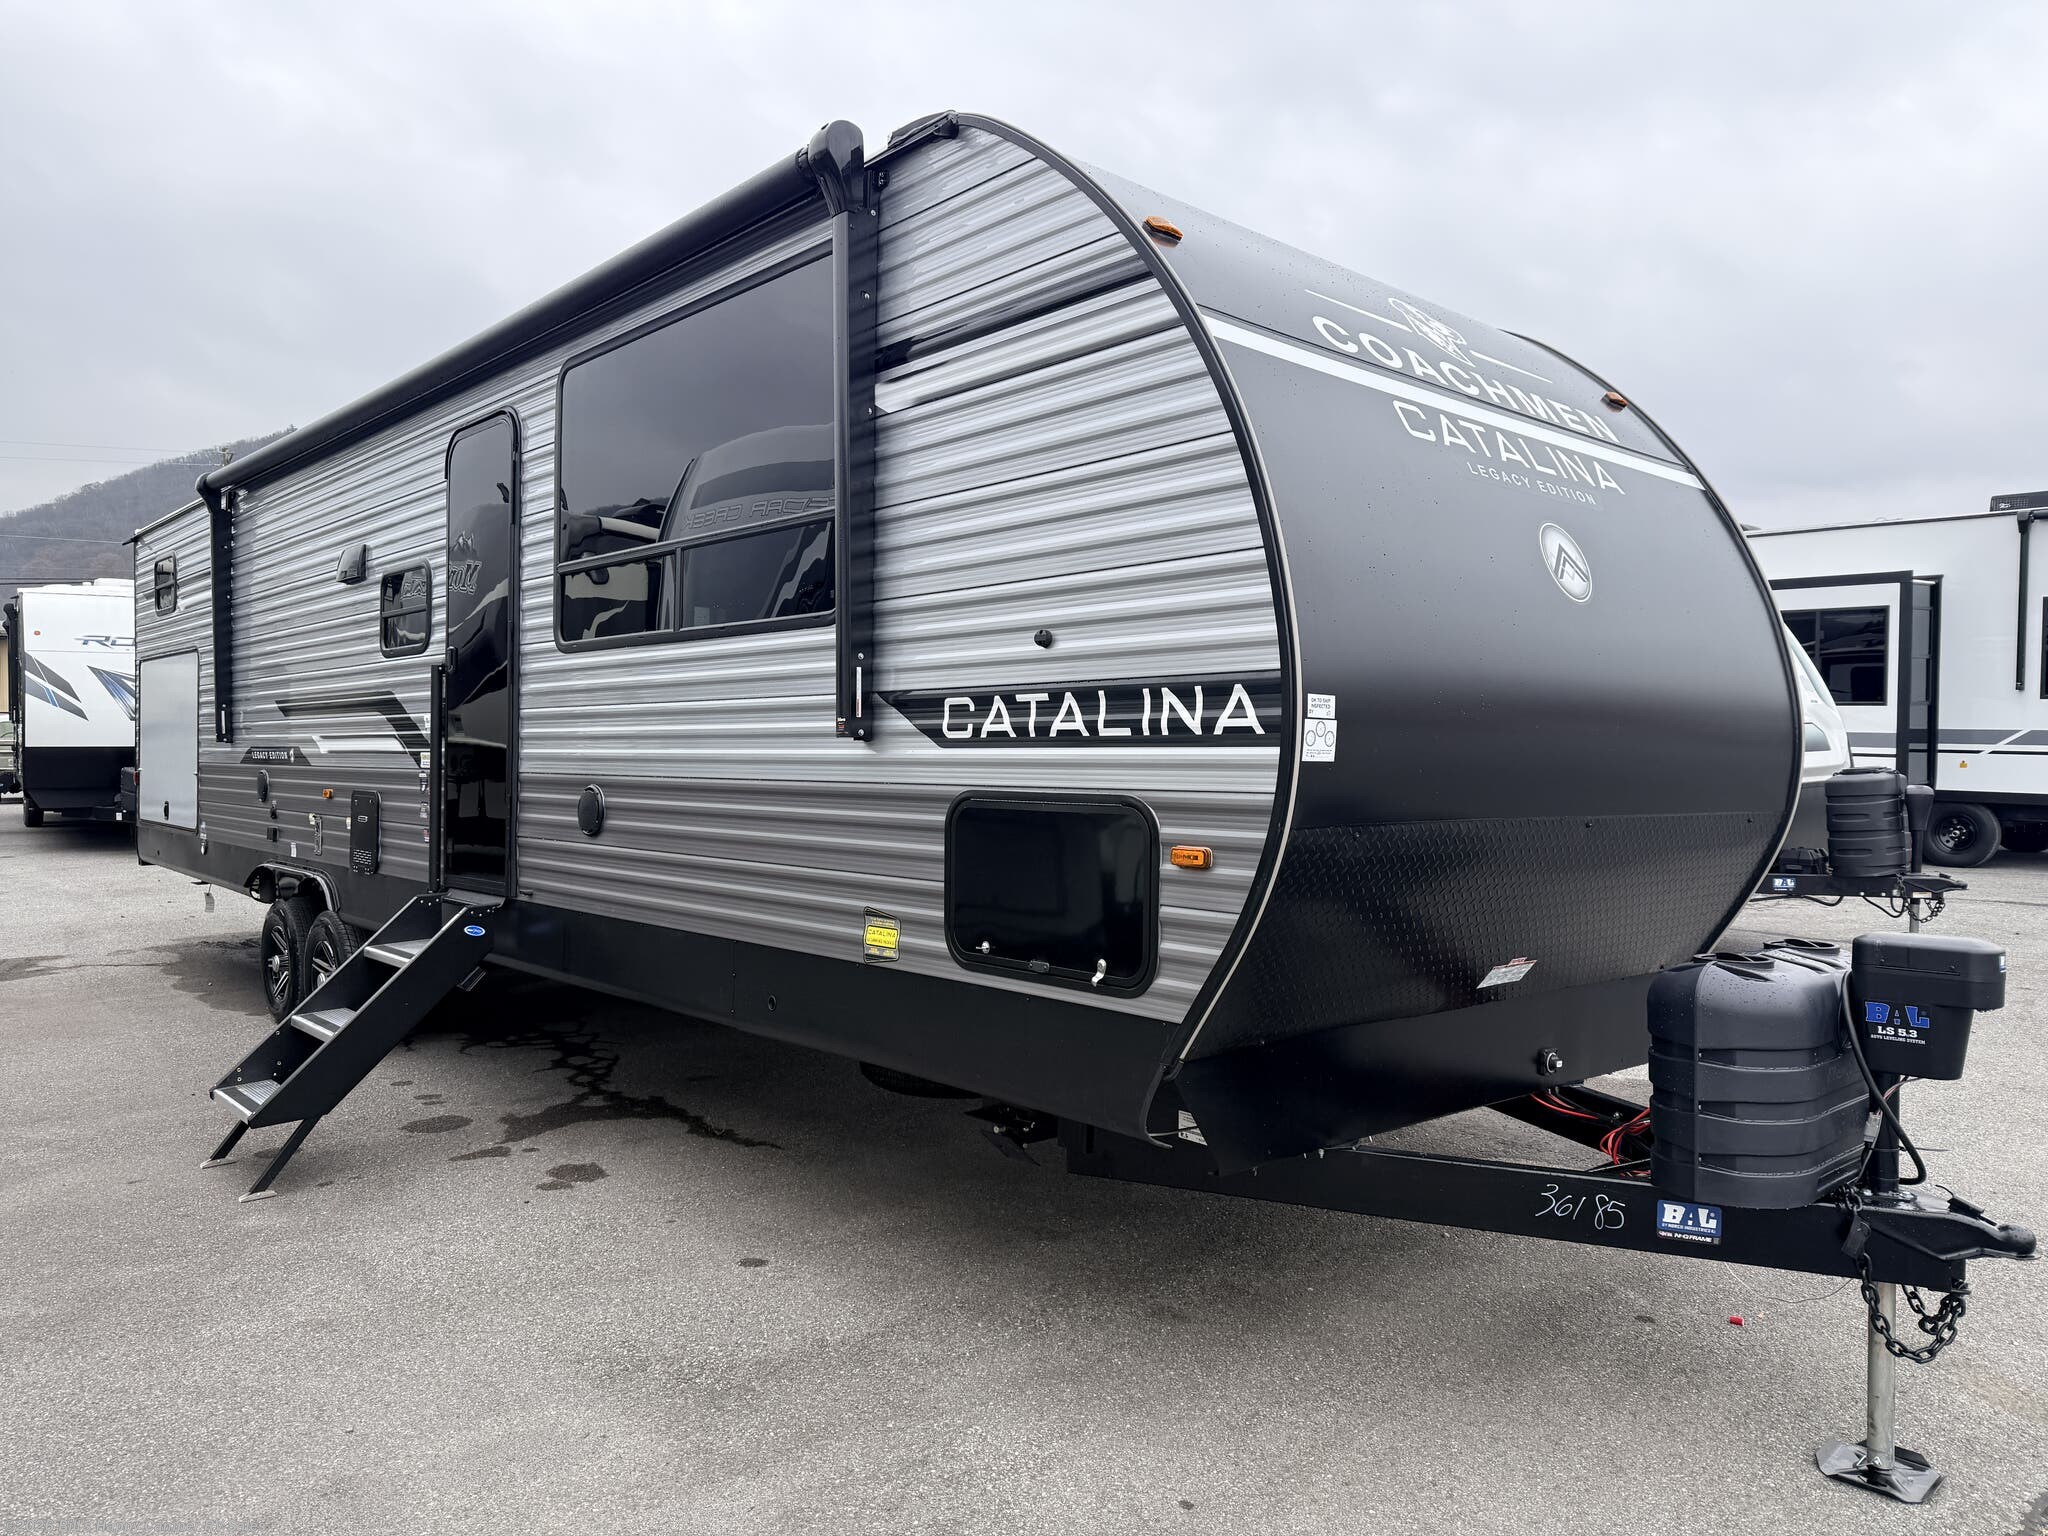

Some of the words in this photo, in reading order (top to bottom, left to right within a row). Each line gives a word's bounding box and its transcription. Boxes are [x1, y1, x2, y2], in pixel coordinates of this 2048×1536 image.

[1312, 316, 1620, 442] COACHMEN
[1393, 400, 1625, 495] CATALINA
[1467, 462, 1530, 489] LEGACY
[1536, 480, 1596, 505] EDITION
[942, 683, 1265, 739] CATALINA
[1865, 1002, 1930, 1029] BAL
[1877, 1025, 1895, 1035] LS
[1897, 1028, 1918, 1038] 5.3
[1662, 1203, 1718, 1229] BAL
